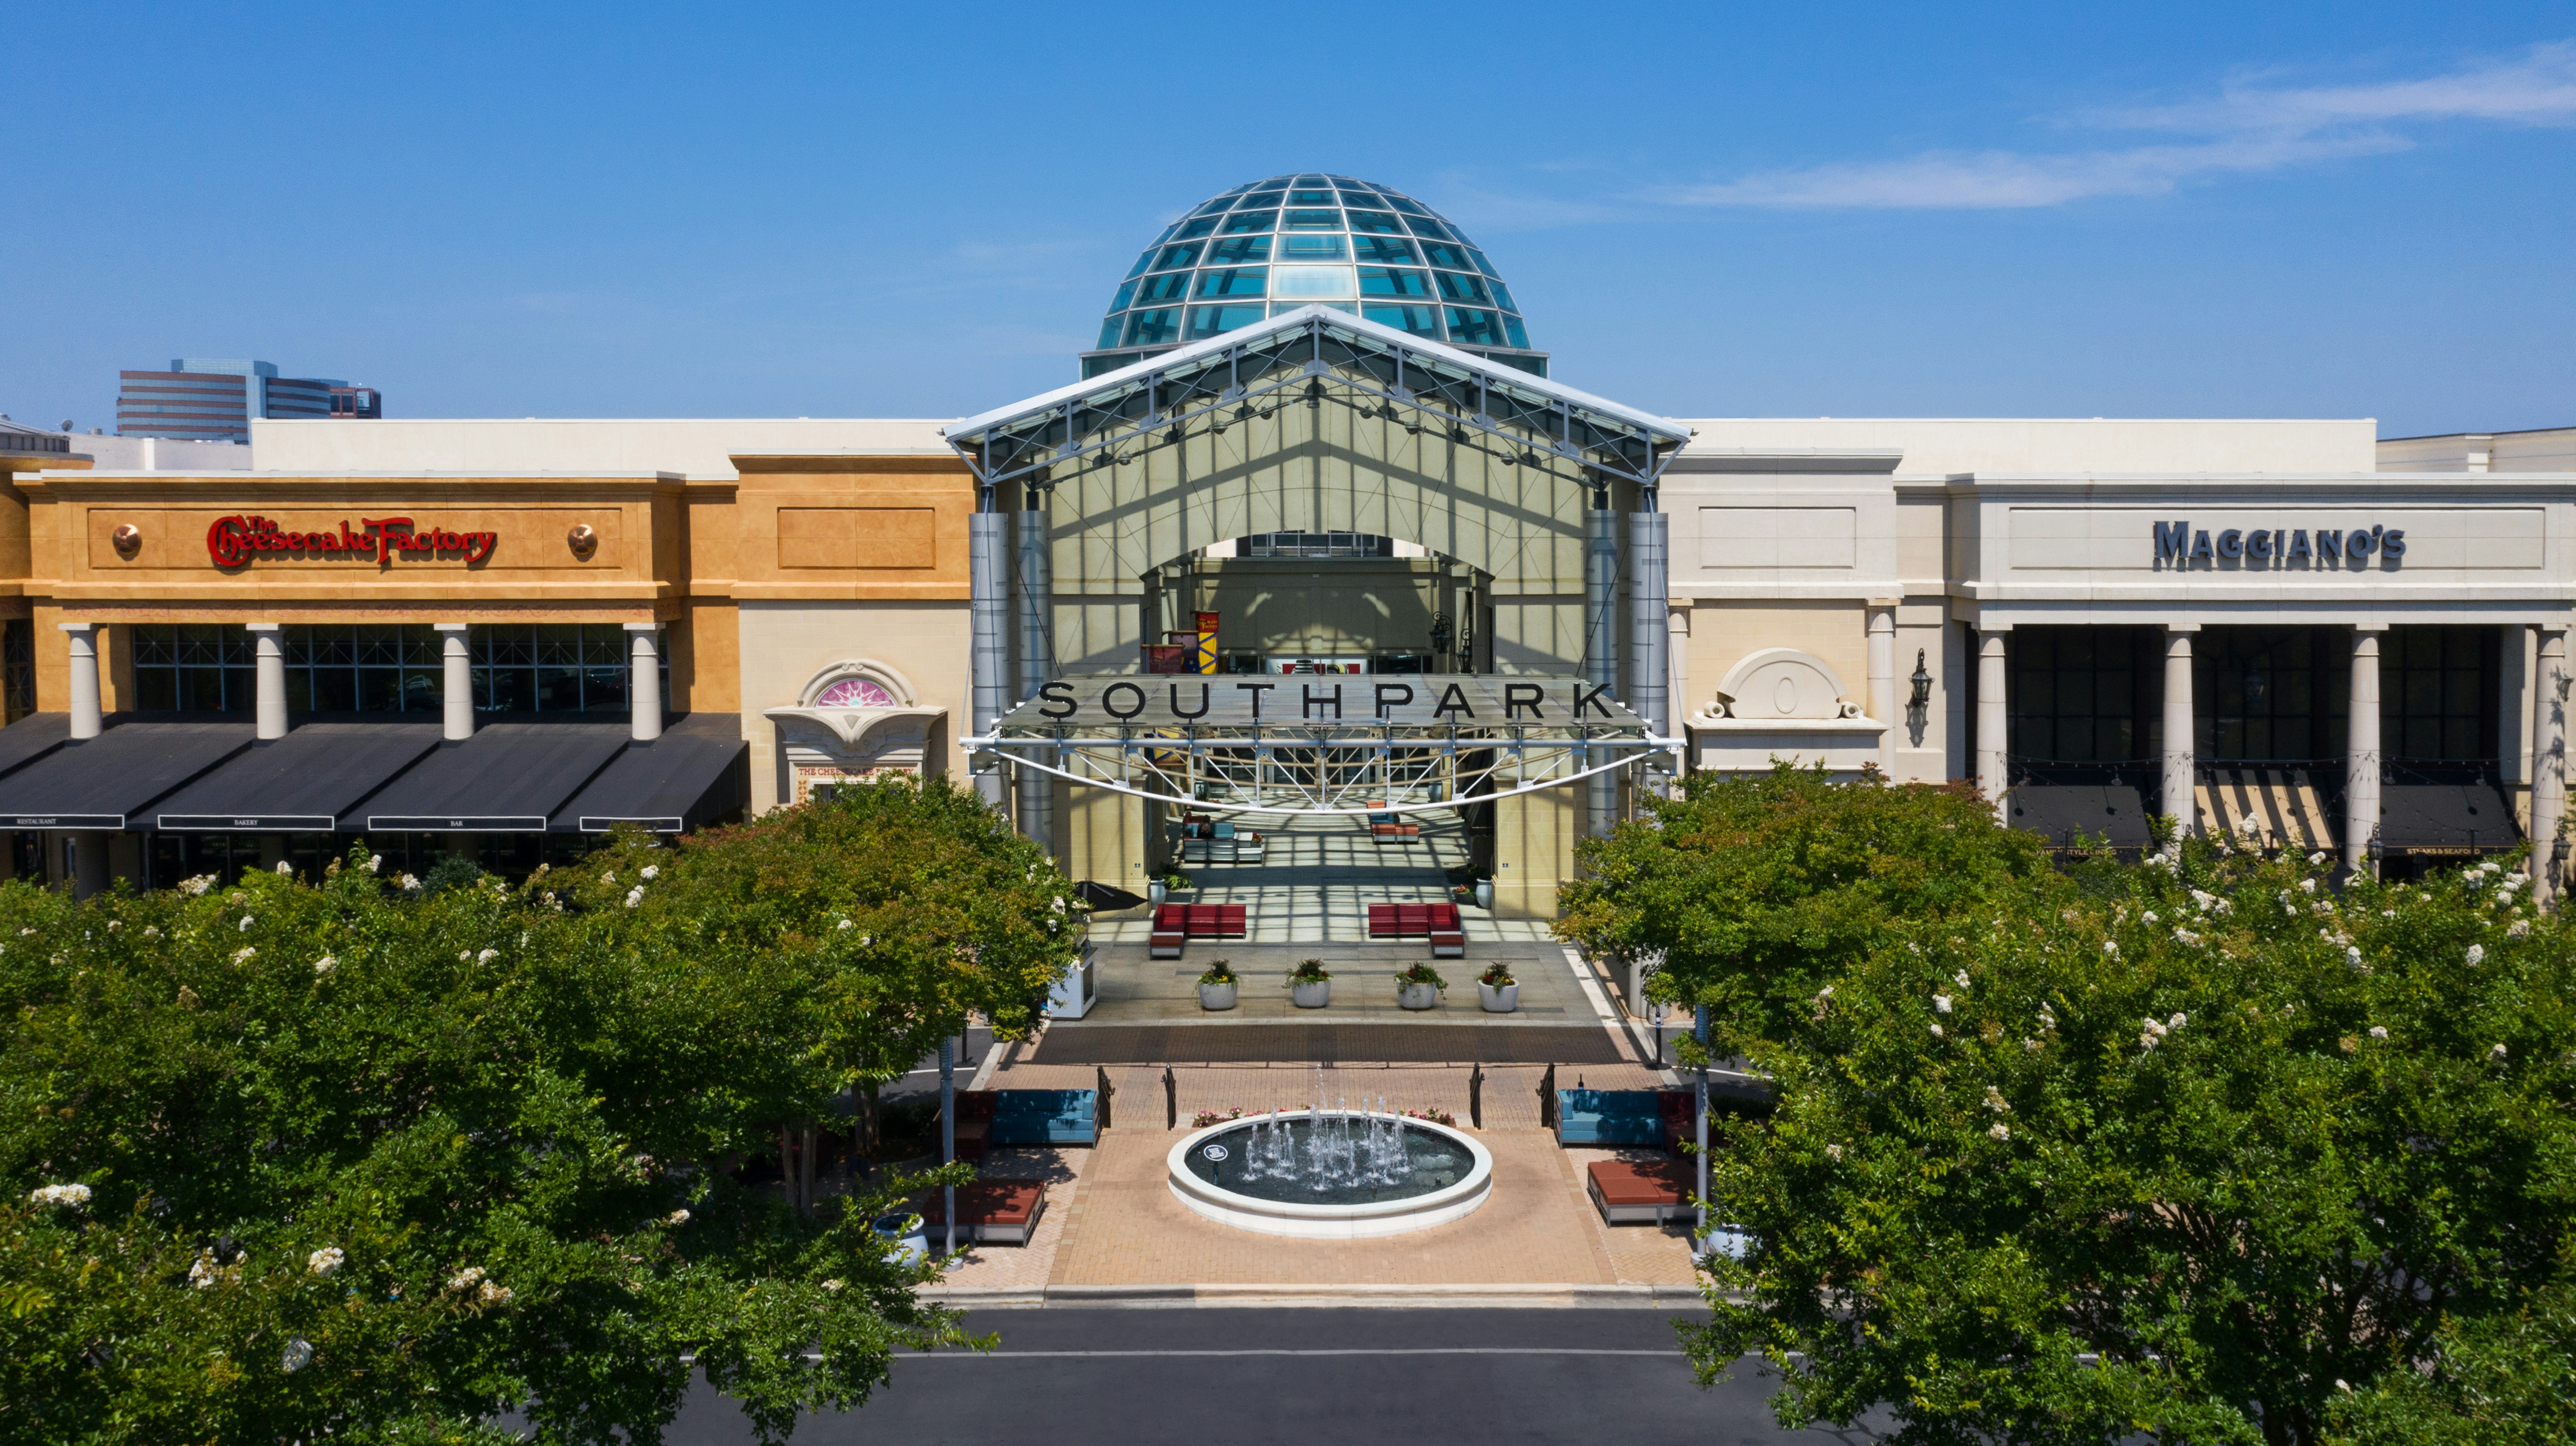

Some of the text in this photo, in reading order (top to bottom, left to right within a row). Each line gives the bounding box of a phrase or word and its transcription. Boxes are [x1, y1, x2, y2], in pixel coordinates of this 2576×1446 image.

[207, 514, 496, 566] Cheesecake Factory
[246, 516, 277, 532] The
[1038, 682, 1613, 719] SOUTHPARK
